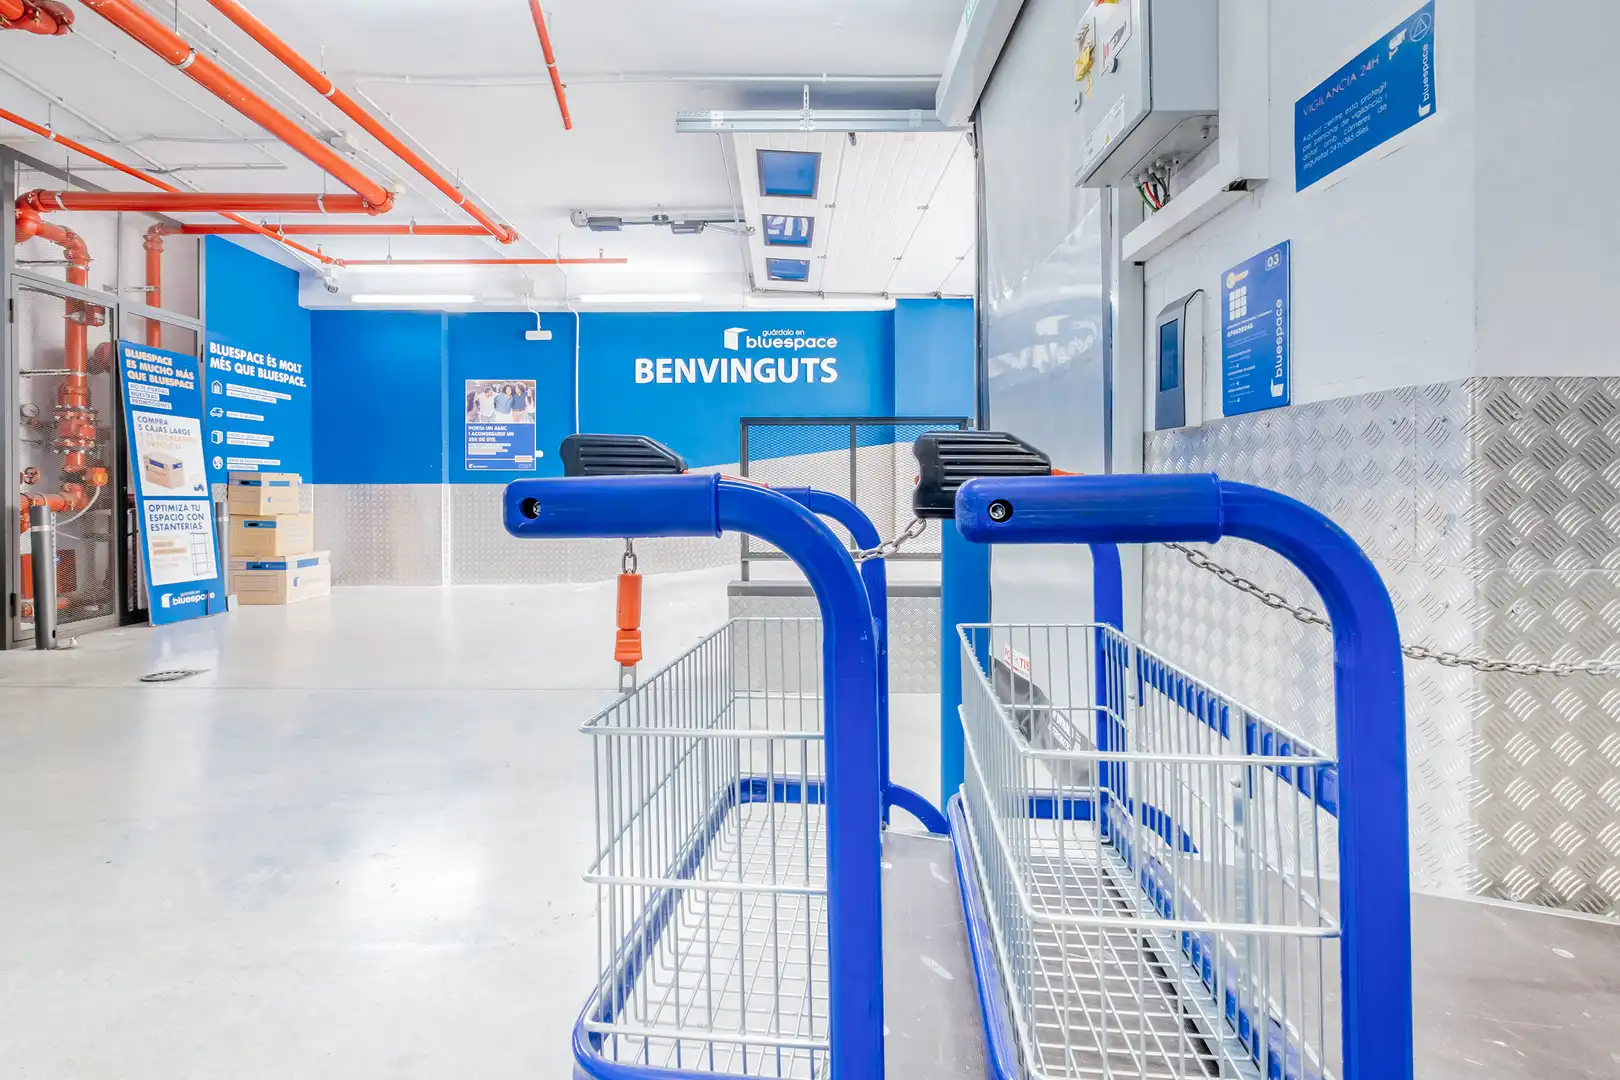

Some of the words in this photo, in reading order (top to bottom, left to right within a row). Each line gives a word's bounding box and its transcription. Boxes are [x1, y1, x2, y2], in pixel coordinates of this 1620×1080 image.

[1360, 53, 1379, 77] 24H
[1422, 44, 1430, 102] bluespace
[1324, 113, 1343, 128] centre
[1361, 81, 1387, 105] protegit
[1303, 142, 1312, 154] per
[1314, 124, 1339, 146] personal
[1341, 118, 1349, 127] de
[1324, 136, 1337, 147] amb
[1377, 104, 1387, 114] de
[1355, 126, 1369, 137] dies
[1267, 253, 1279, 268] 03
[746, 336, 838, 351] bluespace
[1275, 299, 1284, 378] bluespace
[125, 348, 172, 366] BLUESPACE
[209, 341, 265, 365] BLUESPACE
[266, 354, 277, 368] ÉS
[279, 360, 302, 374] MOLT
[126, 359, 137, 369] ES
[139, 362, 174, 376] MUCHO
[175, 369, 195, 380] MÁS
[127, 370, 147, 382] QUE
[149, 374, 195, 390] BLUESPACE
[209, 356, 232, 372] MÉS
[234, 363, 255, 377] QUE
[257, 368, 307, 388] BLUESPACE.
[635, 357, 838, 384] BENVINGUTS
[137, 416, 168, 425] COMPRA
[145, 424, 168, 434] CAJAS
[169, 428, 192, 436] LARGE
[148, 504, 188, 512] OPTIMIZA
[191, 504, 200, 512] TU
[149, 513, 184, 521] ESPACIO
[187, 513, 204, 521] CON
